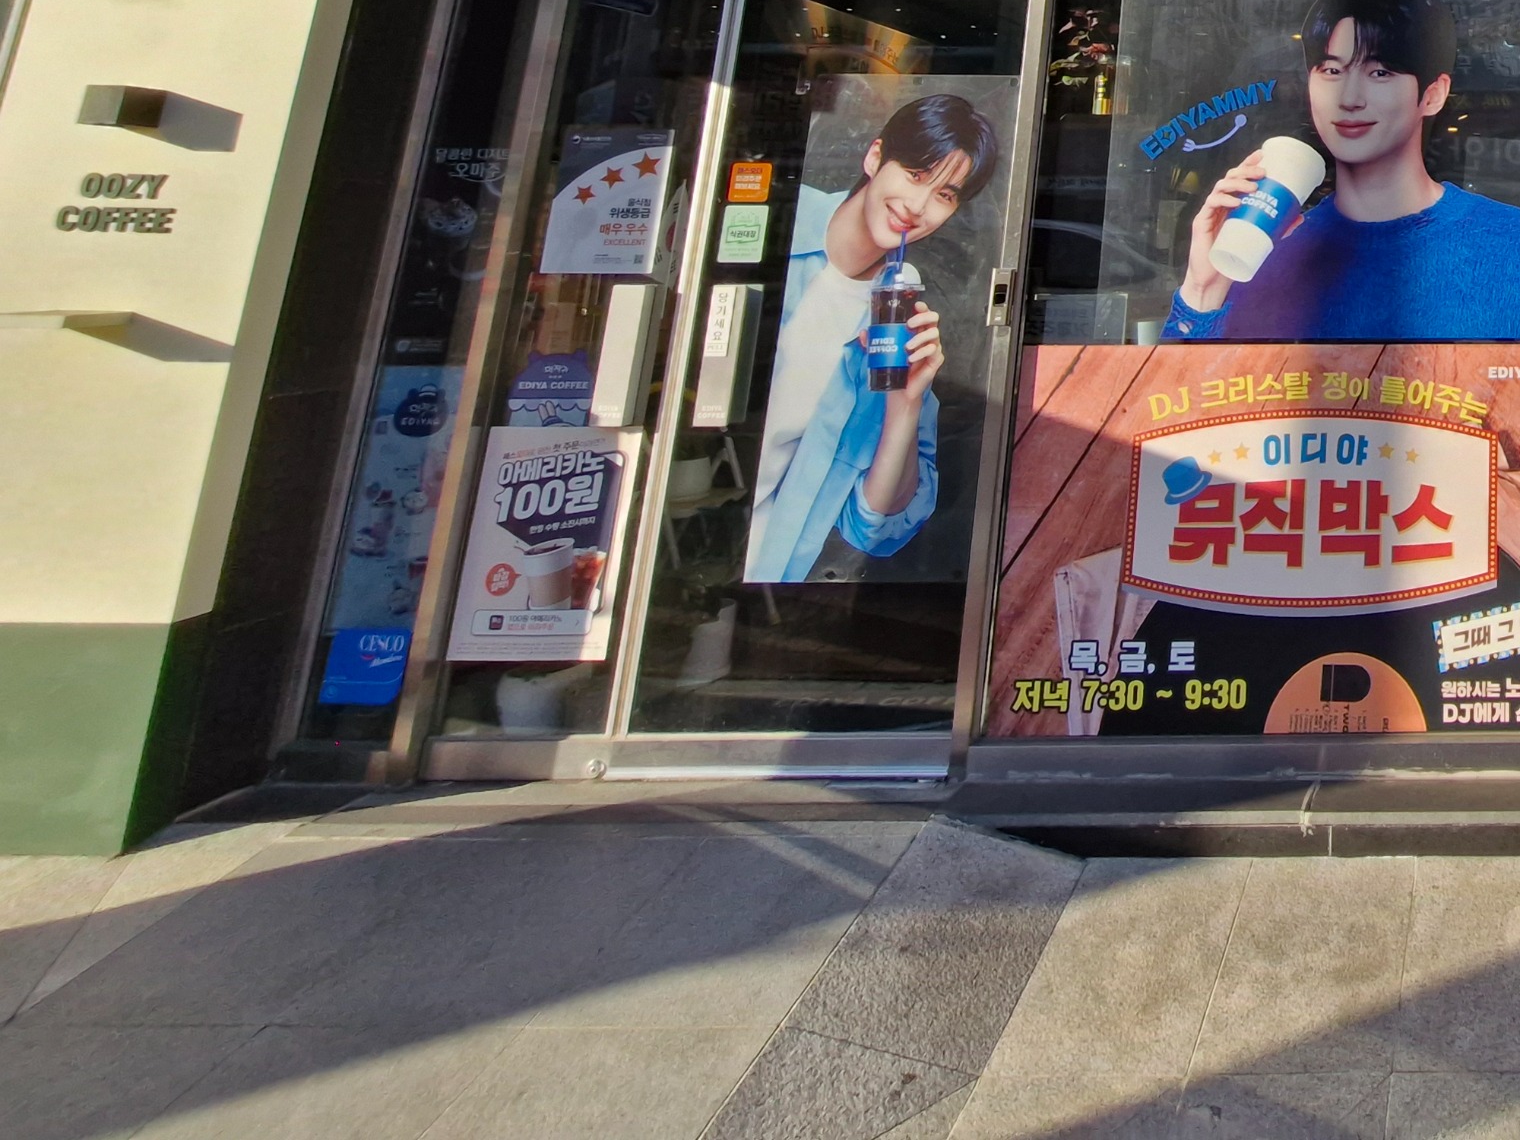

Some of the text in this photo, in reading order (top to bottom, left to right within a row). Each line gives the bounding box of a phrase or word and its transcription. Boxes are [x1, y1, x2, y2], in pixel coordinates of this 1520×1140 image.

[1139, 79, 1278, 161] EDIYAMMY
[80, 172, 170, 200] OOZY
[56, 205, 178, 234] COFFEE
[1241, 196, 1279, 219] COFFEE
[603, 238, 647, 246] EXCELLENT
[625, 223, 649, 235] 우수
[729, 230, 757, 238] 식권대장
[713, 292, 728, 341] 당기세요
[518, 381, 589, 390] EDIYA COFFEE
[1149, 371, 1489, 425] DJ 크리스탈 정이 틀어주는
[1262, 432, 1369, 466] 이디야
[497, 450, 605, 486] 아메리카노
[494, 471, 604, 524] 100원
[359, 634, 405, 652] CESCO
[1453, 625, 1491, 652] 그때
[1497, 619, 1514, 643] 그
[1070, 640, 1196, 674] 목, 금, 토
[1012, 680, 1070, 713] 저녁
[1081, 679, 1145, 711] 7:30
[1184, 678, 1247, 710] 9:30
[1440, 681, 1501, 699] 원하시는
[1442, 702, 1510, 724] DJ에게
